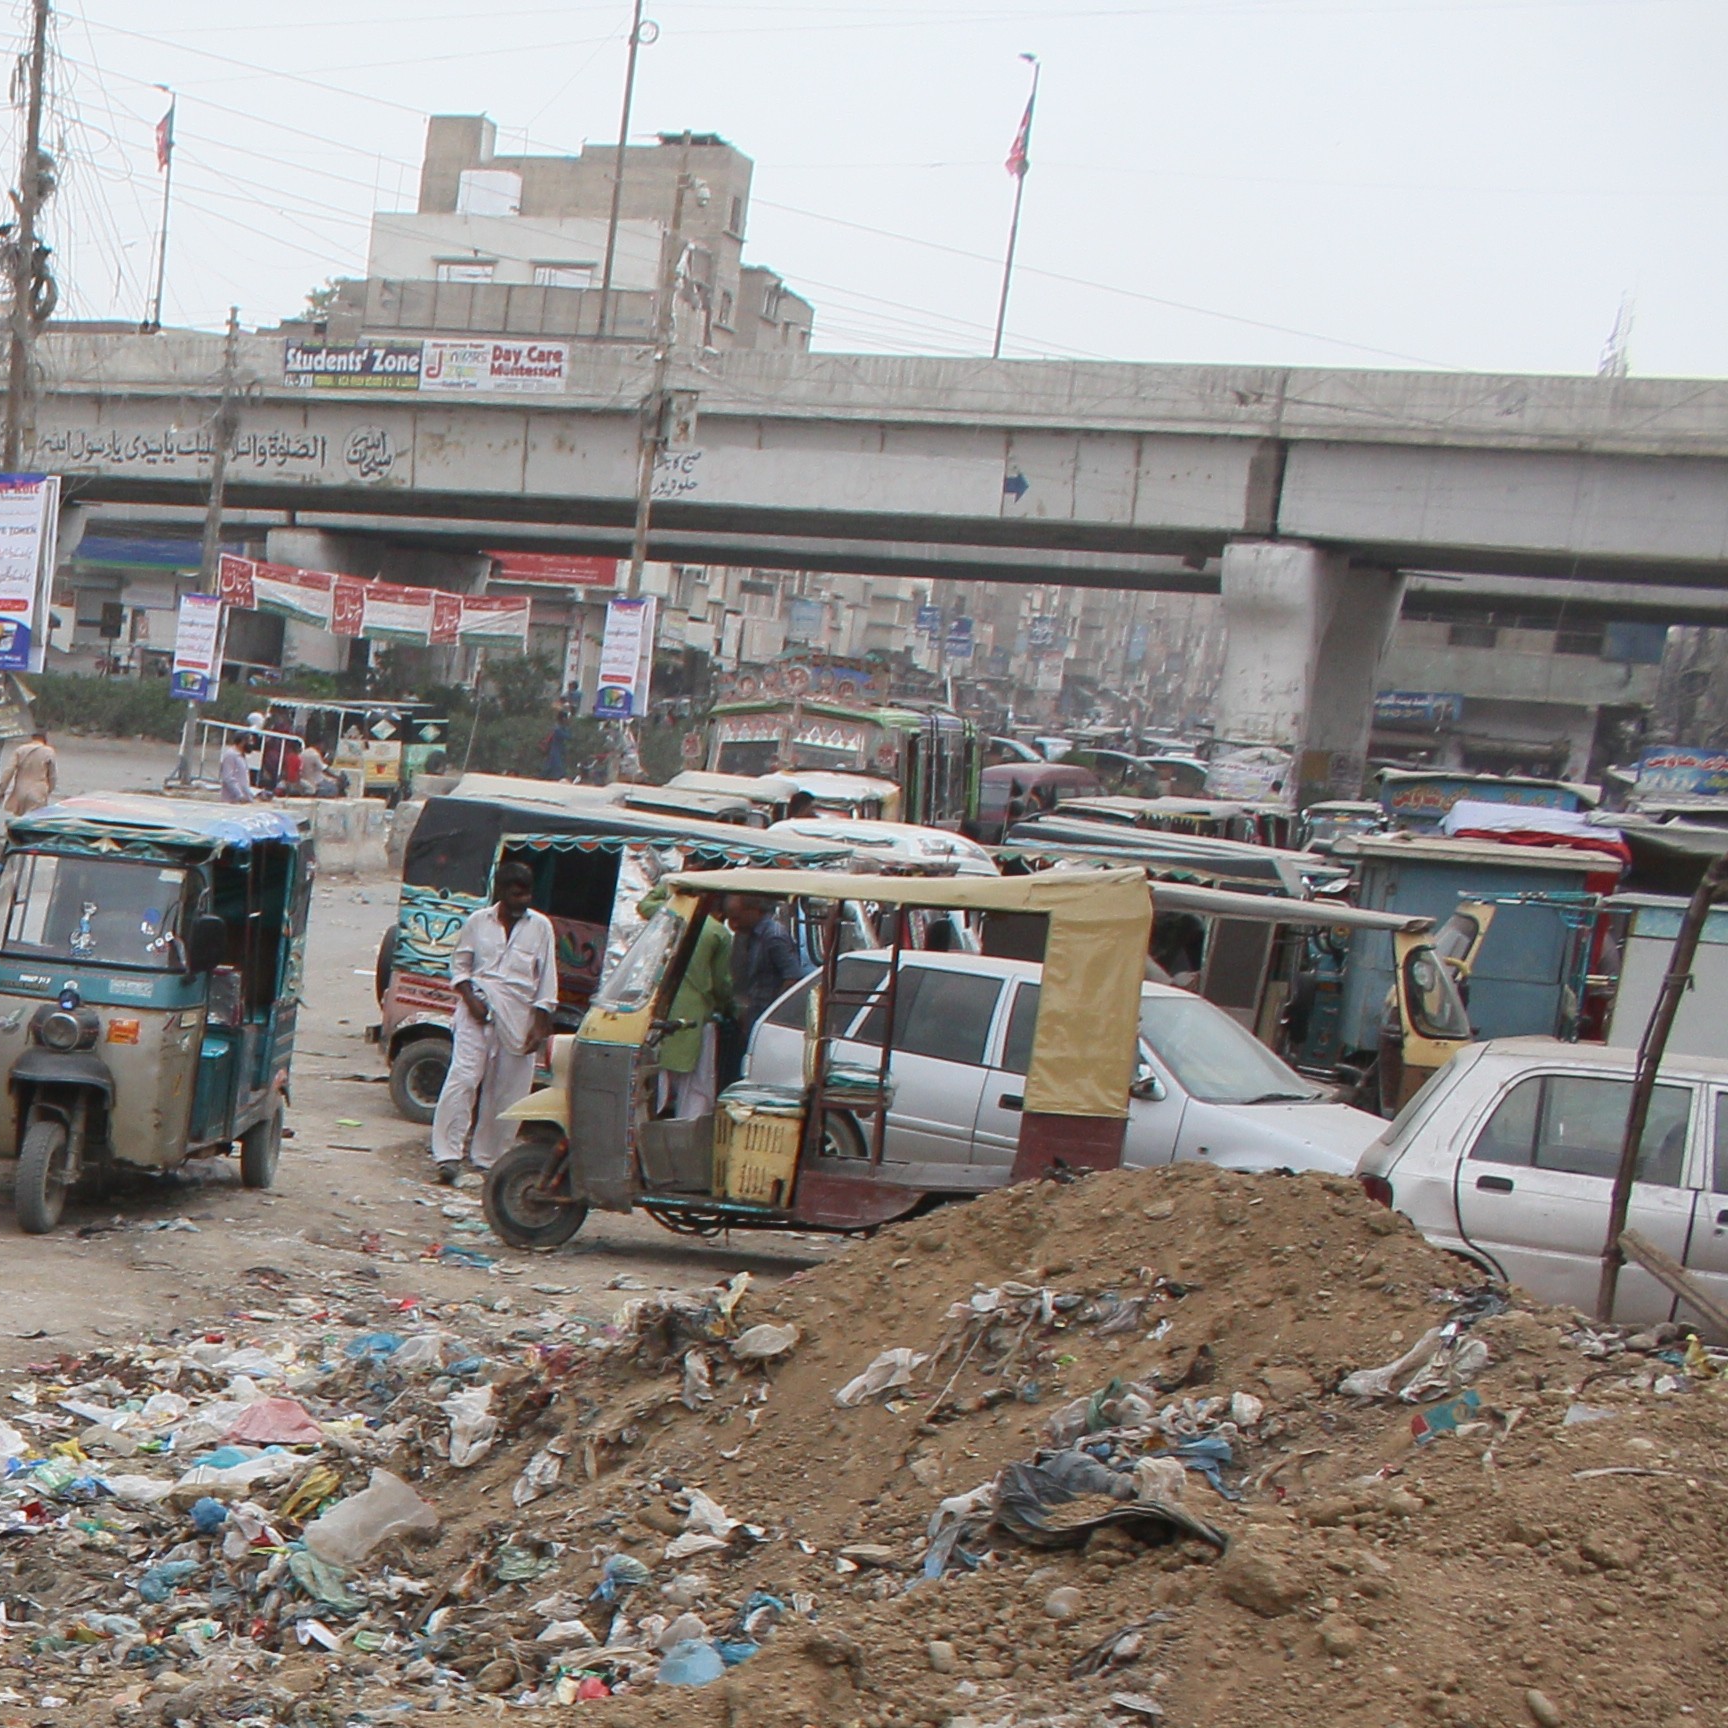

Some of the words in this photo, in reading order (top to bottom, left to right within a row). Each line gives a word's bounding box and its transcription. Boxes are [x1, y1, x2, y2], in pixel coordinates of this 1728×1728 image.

[372, 350, 420, 372] Zone
[492, 344, 524, 364] Day
[527, 346, 563, 362] Care
[8, 525, 37, 536] TOKEN
